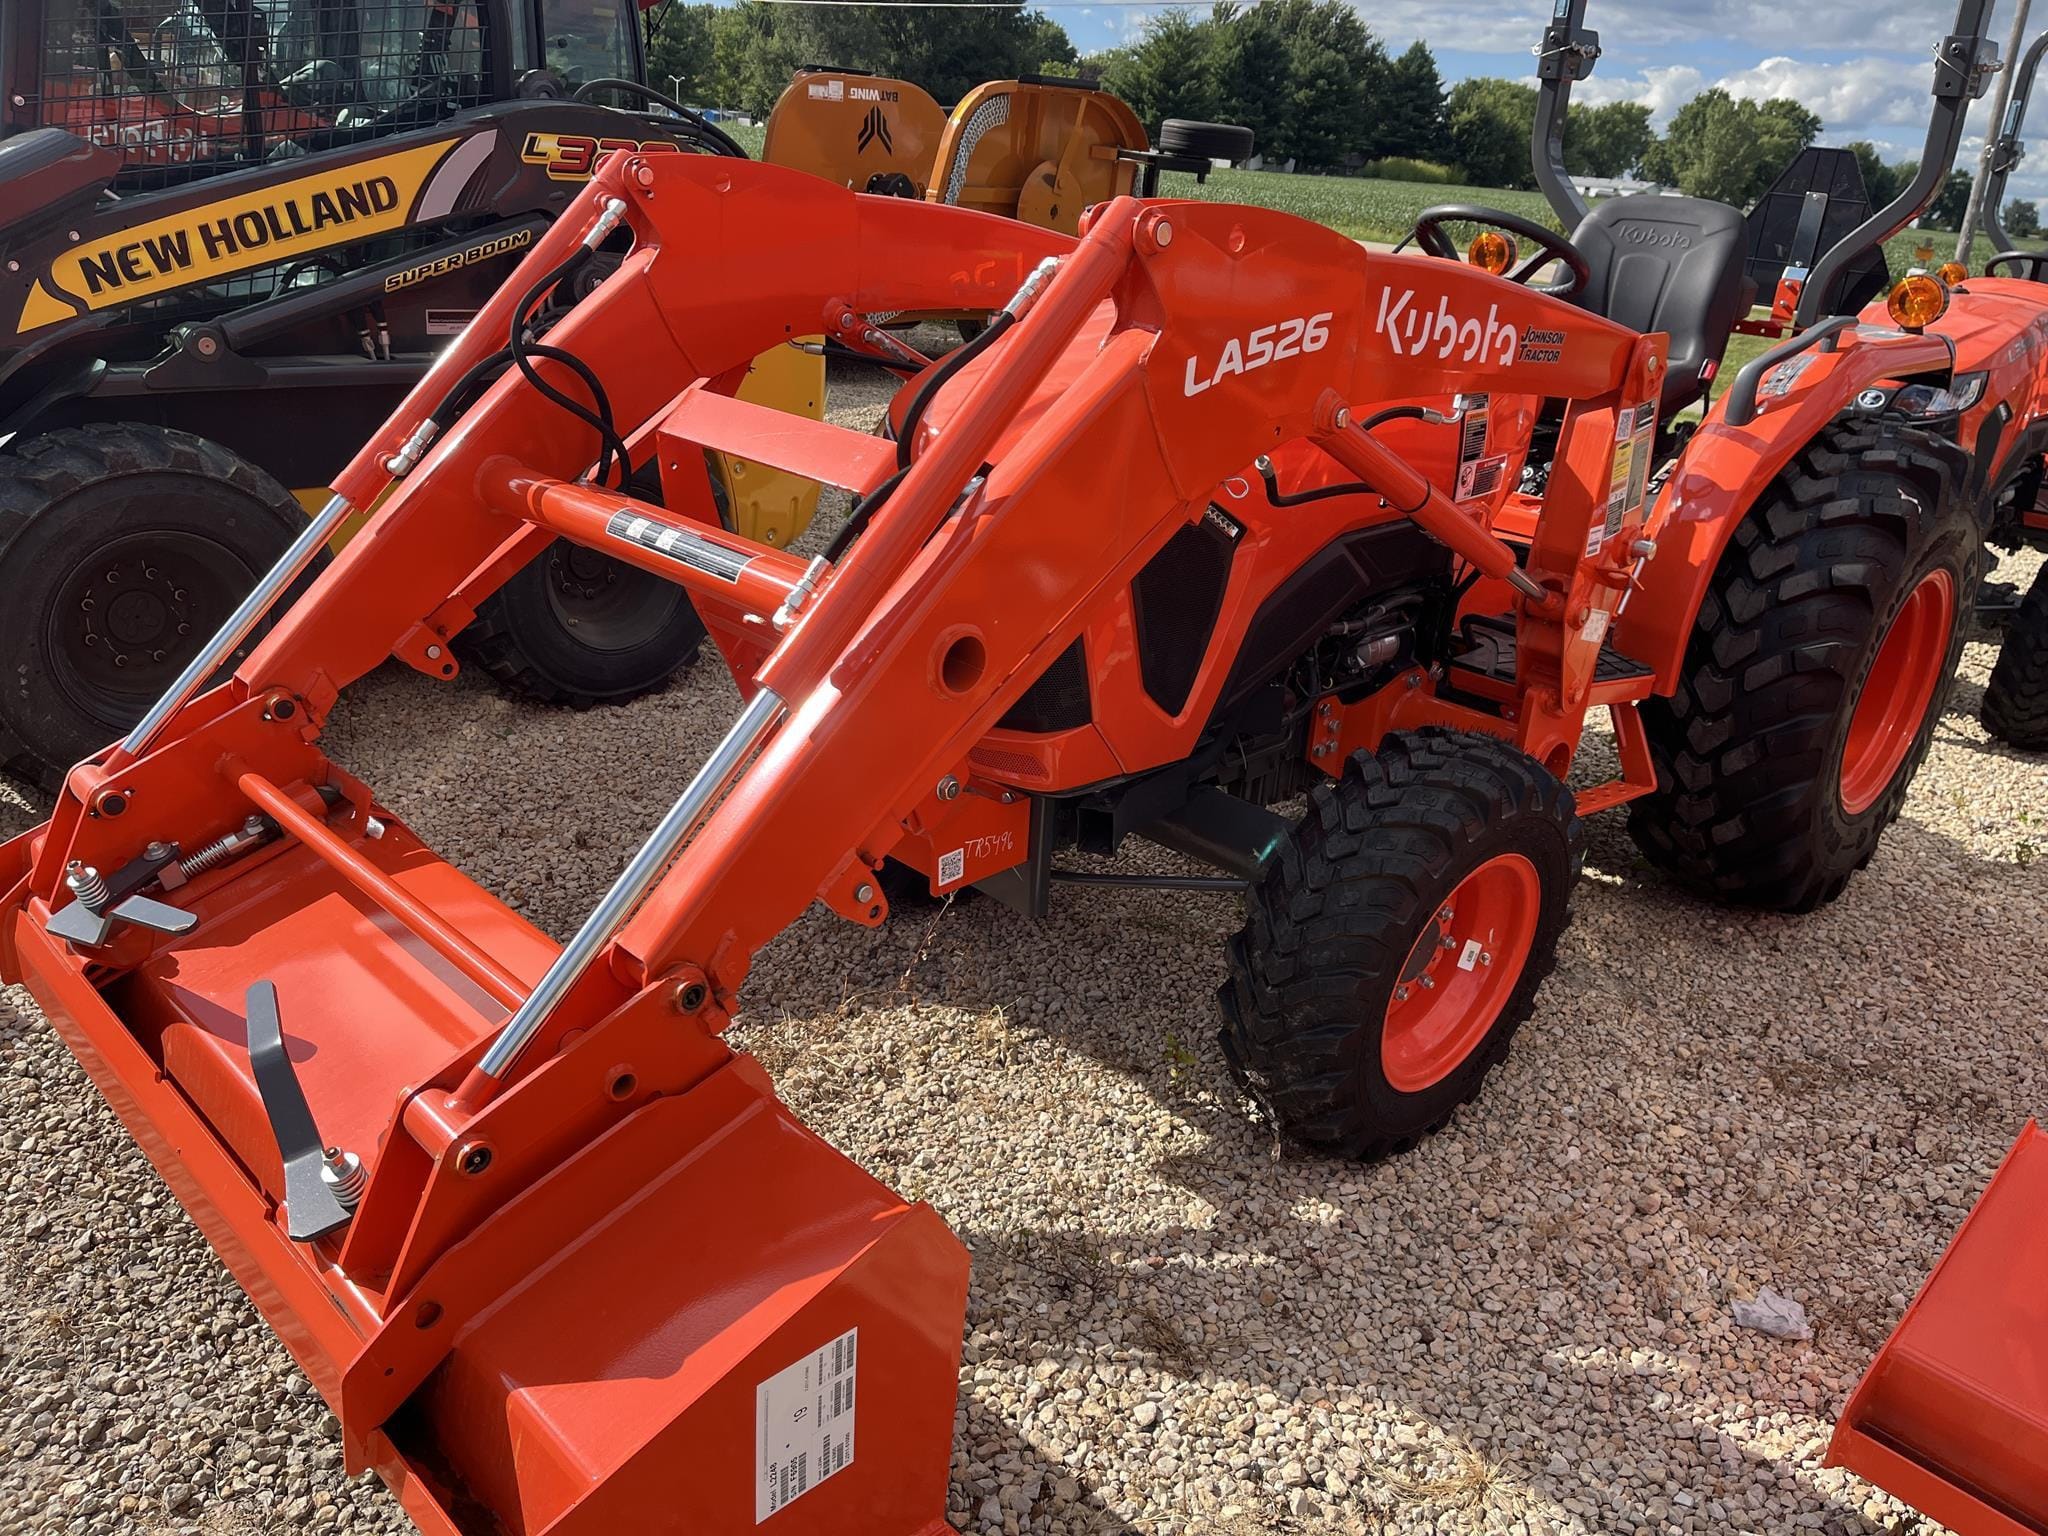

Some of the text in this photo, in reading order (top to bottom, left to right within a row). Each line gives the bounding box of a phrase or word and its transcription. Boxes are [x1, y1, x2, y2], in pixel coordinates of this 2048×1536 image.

[78, 175, 399, 296] NEW HOLLAND
[385, 230, 531, 292] SUPER BOOM
[1618, 225, 1691, 248] Kubota
[1184, 312, 1333, 397] LA526
[1375, 285, 1517, 367] Kubota
[1518, 343, 1561, 362] TRACTOR
[1520, 325, 1566, 345] JOHNSON
